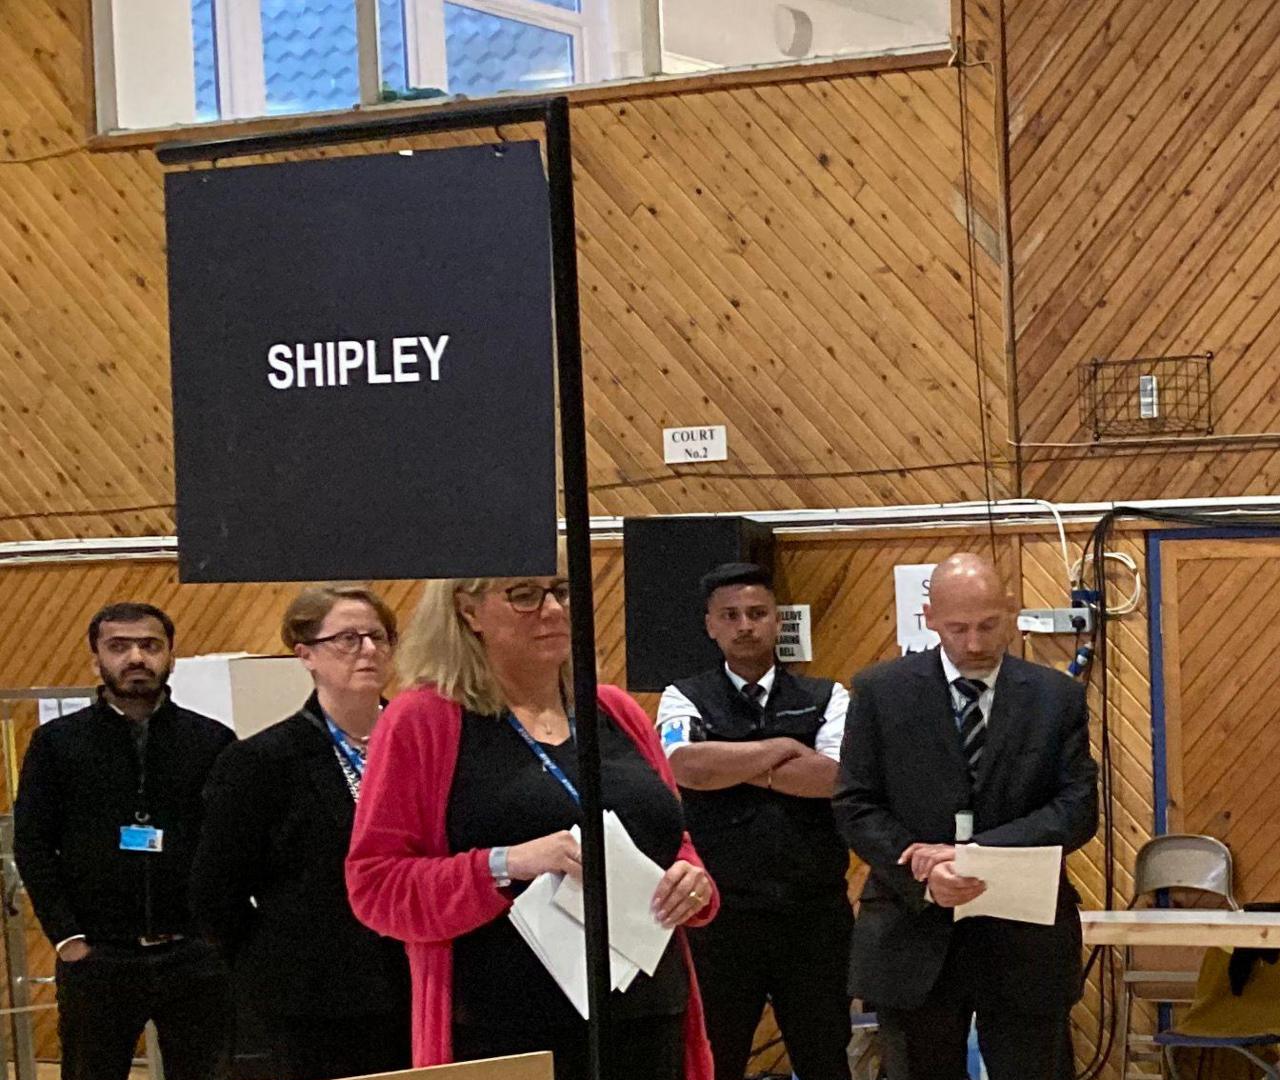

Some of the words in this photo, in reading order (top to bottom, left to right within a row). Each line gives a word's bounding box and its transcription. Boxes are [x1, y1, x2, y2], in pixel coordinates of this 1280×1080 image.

[267, 335, 449, 390] SHIPLEY
[671, 428, 716, 443] COURT
[684, 446, 708, 459] No.2
